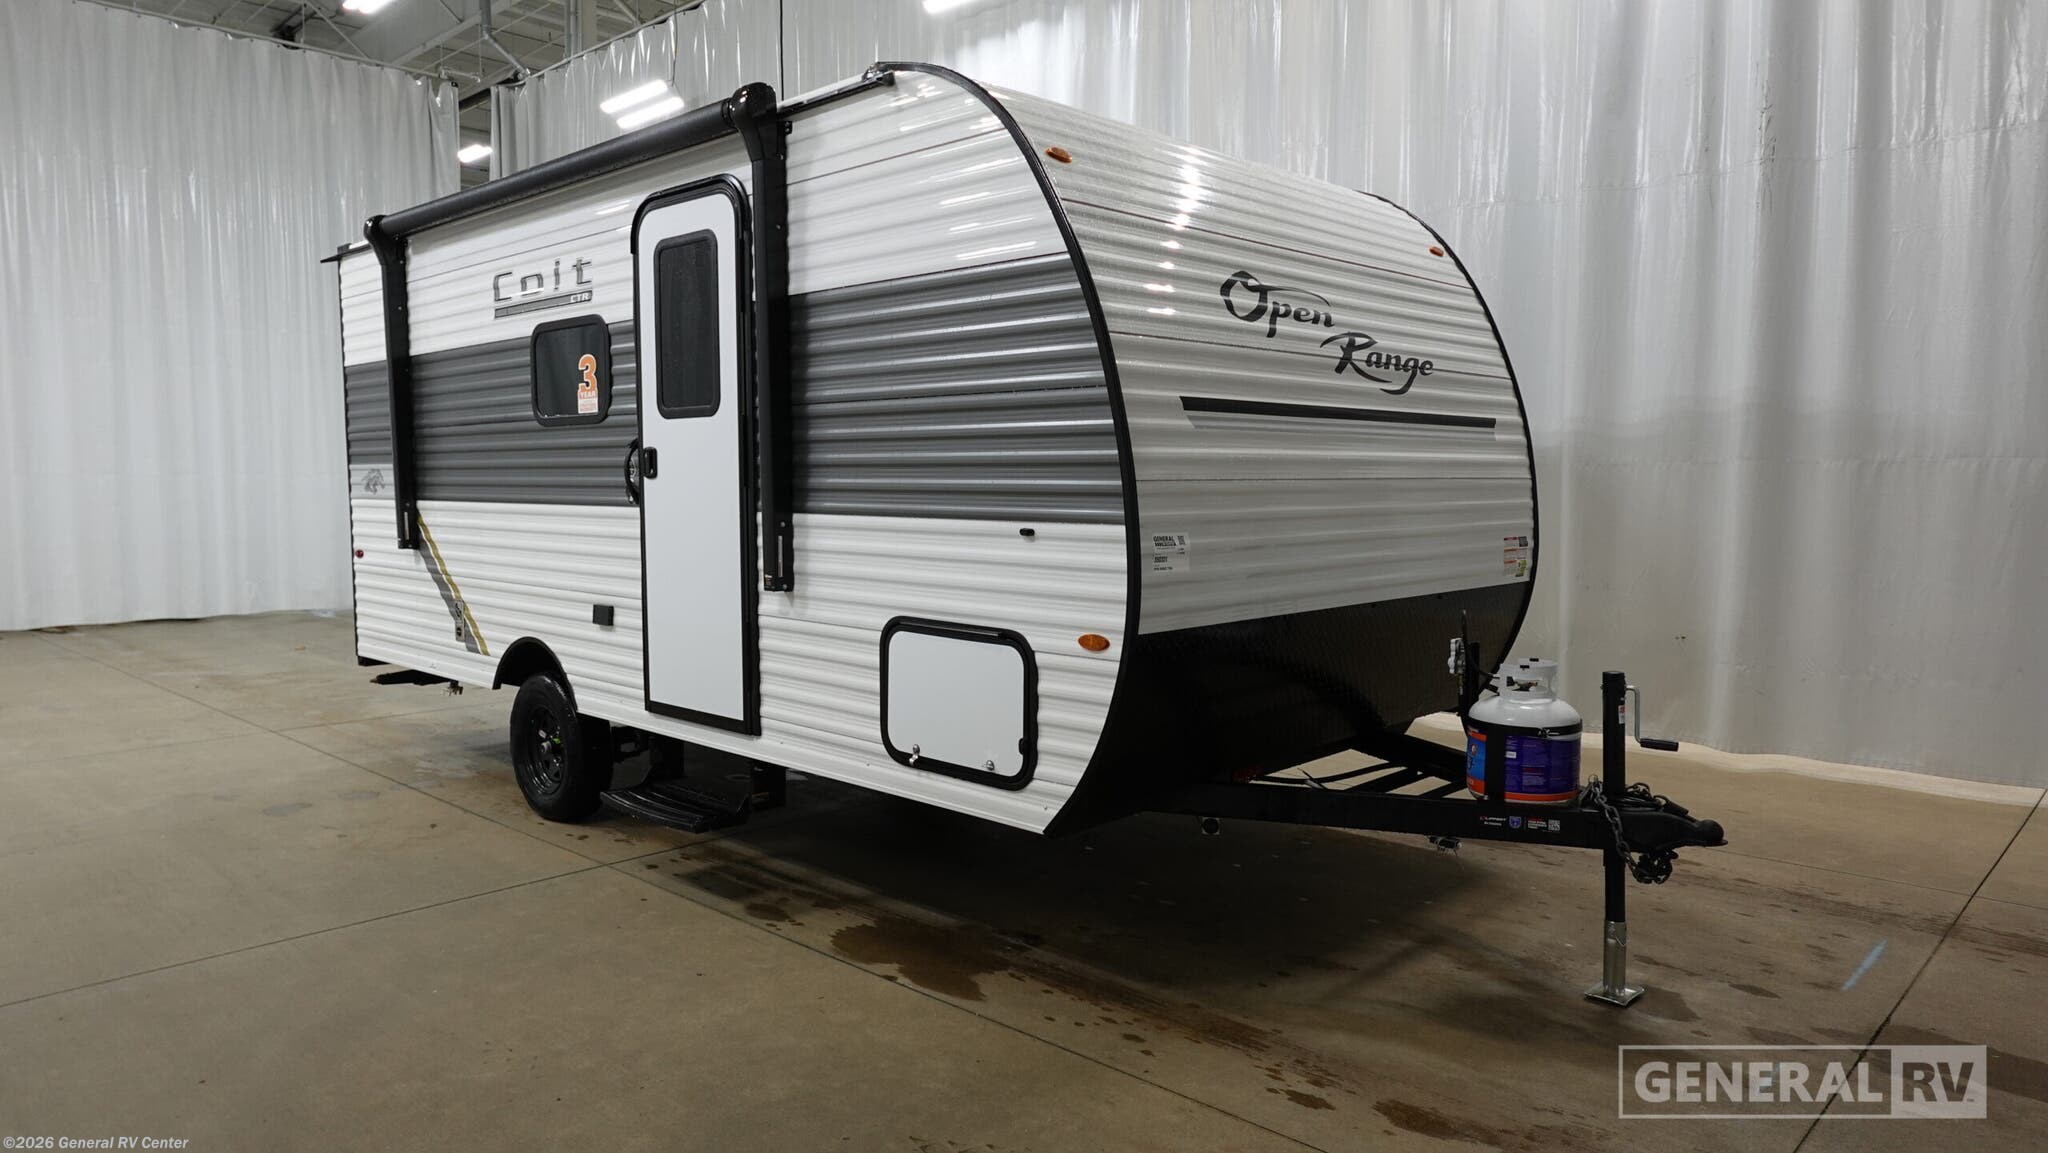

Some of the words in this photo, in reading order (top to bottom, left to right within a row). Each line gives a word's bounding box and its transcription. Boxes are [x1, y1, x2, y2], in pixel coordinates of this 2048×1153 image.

[570, 293, 590, 302] CTR
[1220, 271, 1335, 338] Open
[578, 354, 597, 392] 3
[1320, 332, 1433, 395] Range
